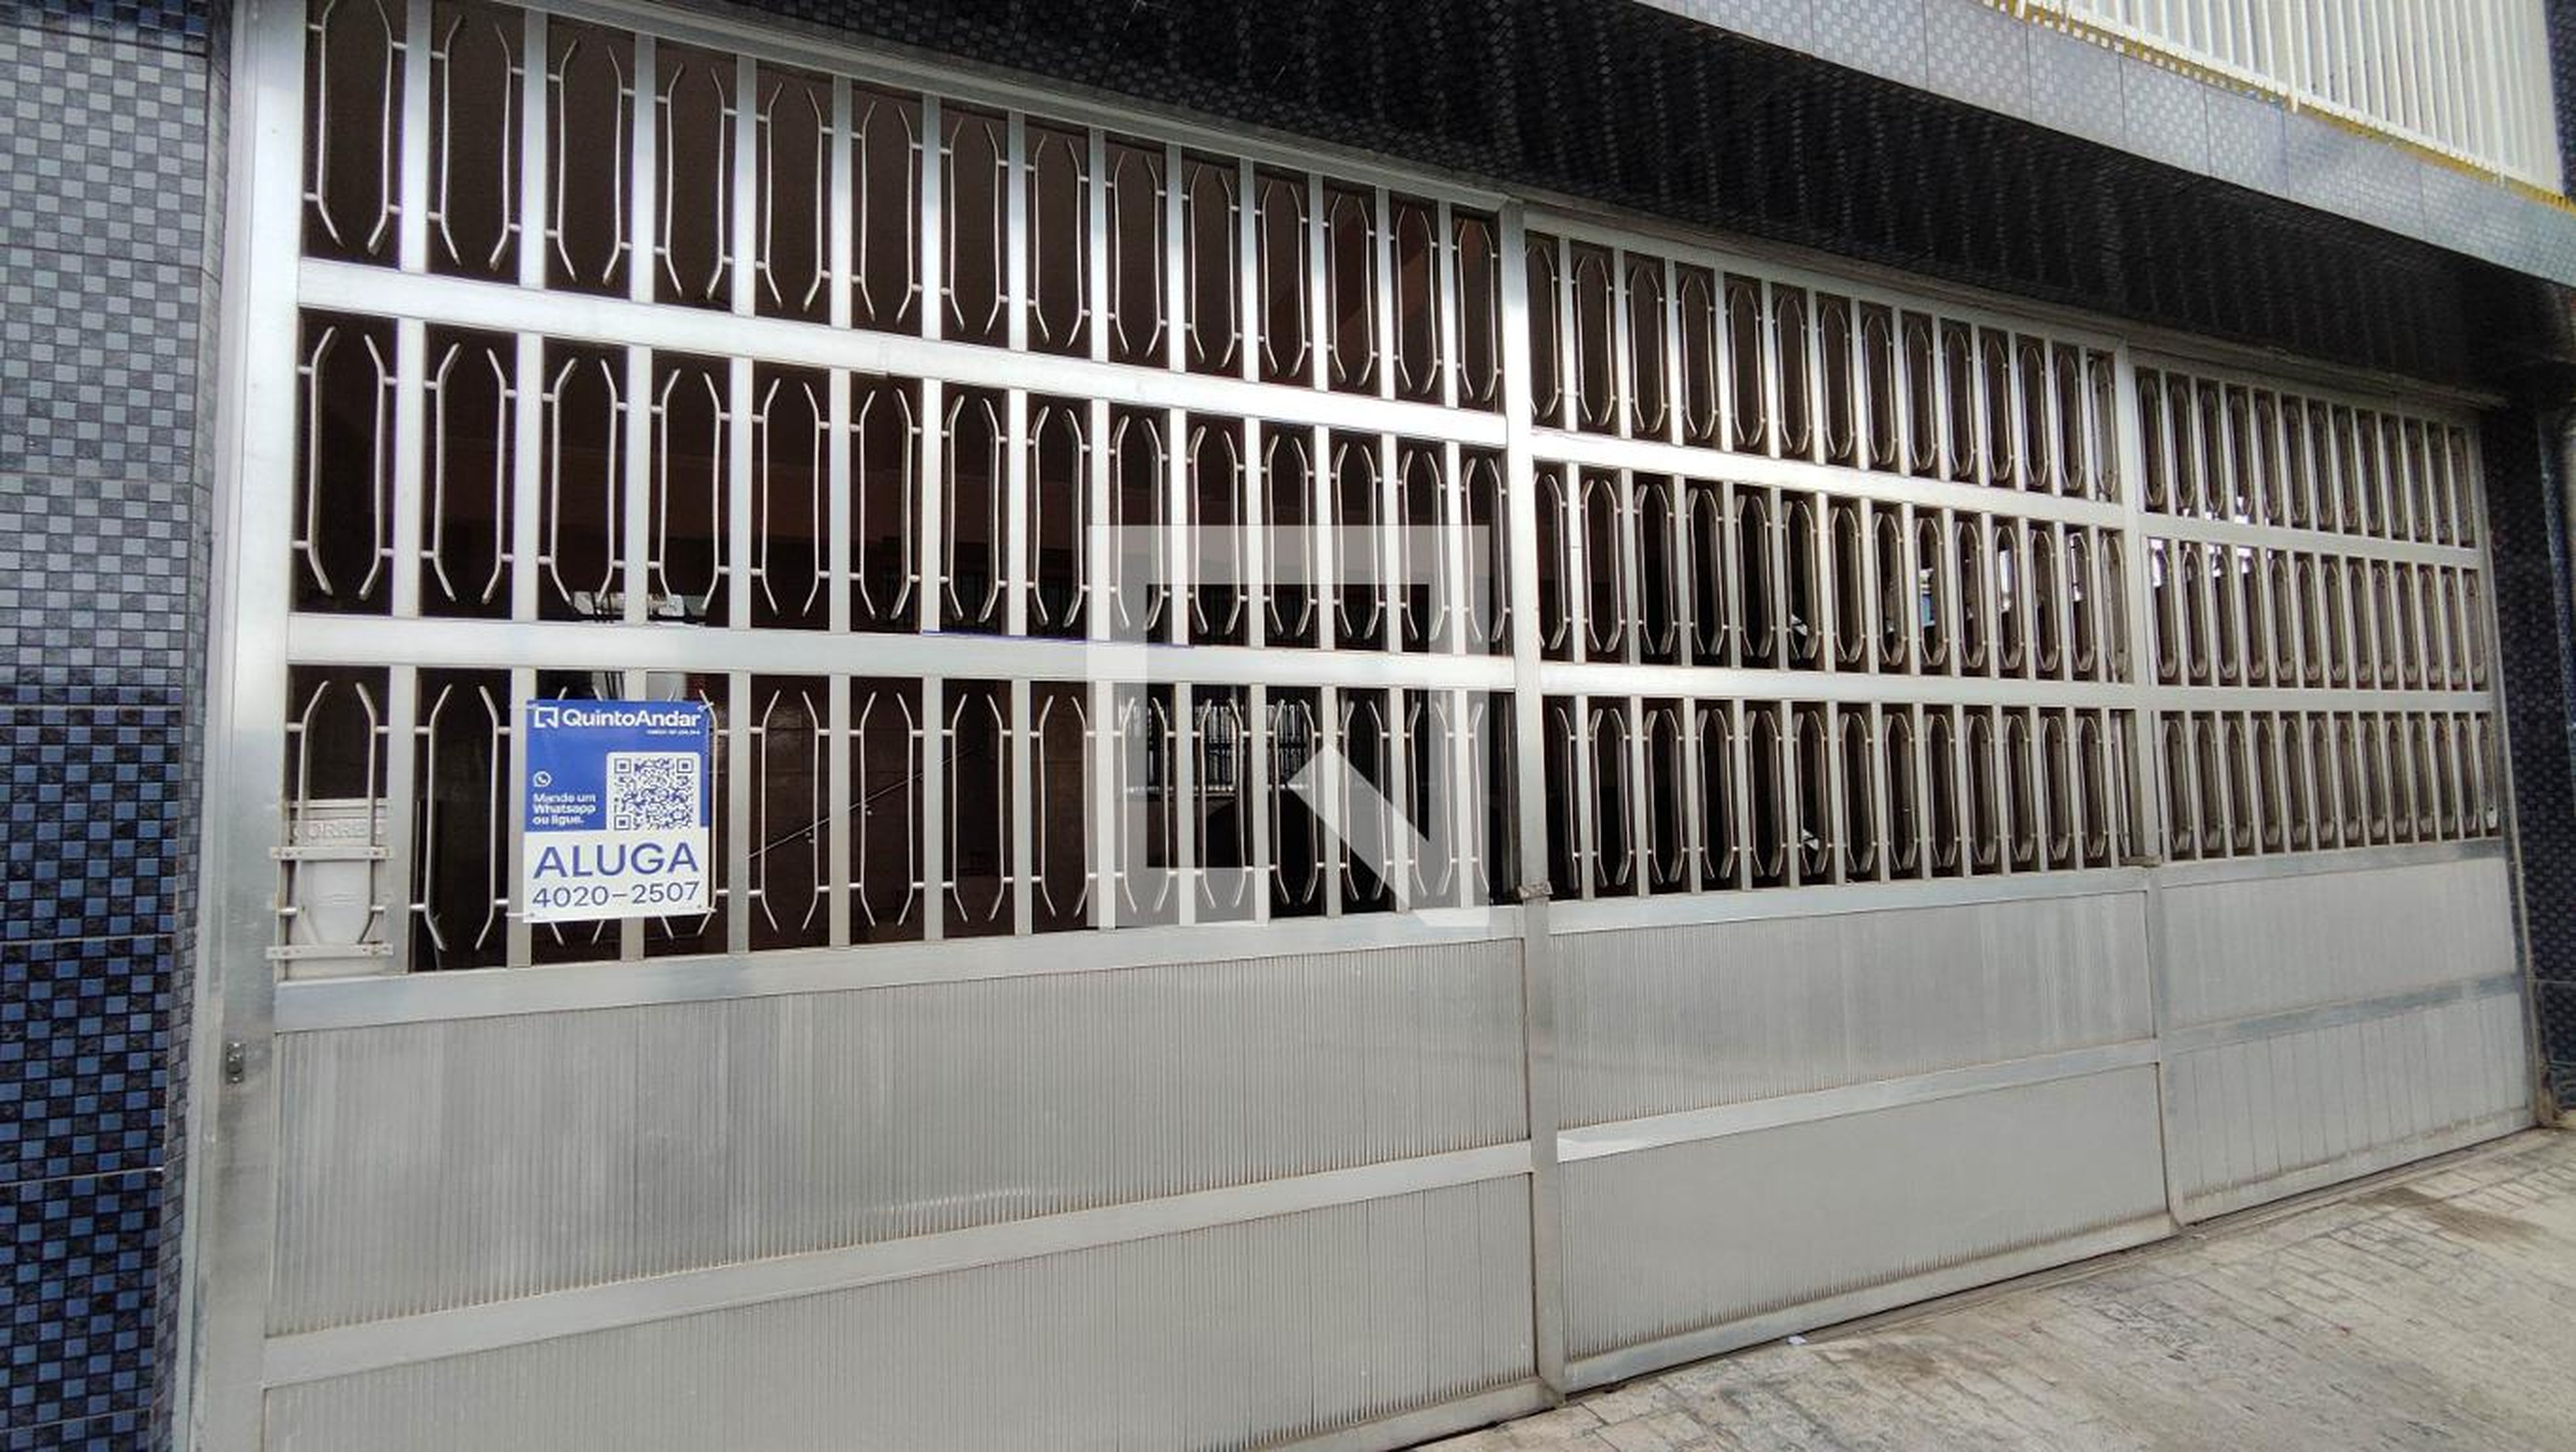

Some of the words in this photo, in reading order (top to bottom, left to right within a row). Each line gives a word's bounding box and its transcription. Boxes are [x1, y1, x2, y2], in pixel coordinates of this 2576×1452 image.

[562, 710, 702, 727] QuintoAndar
[578, 794, 596, 802] um
[533, 817, 549, 825] ou
[533, 842, 699, 879] ALUGA
[533, 881, 700, 908] 4020-2507
